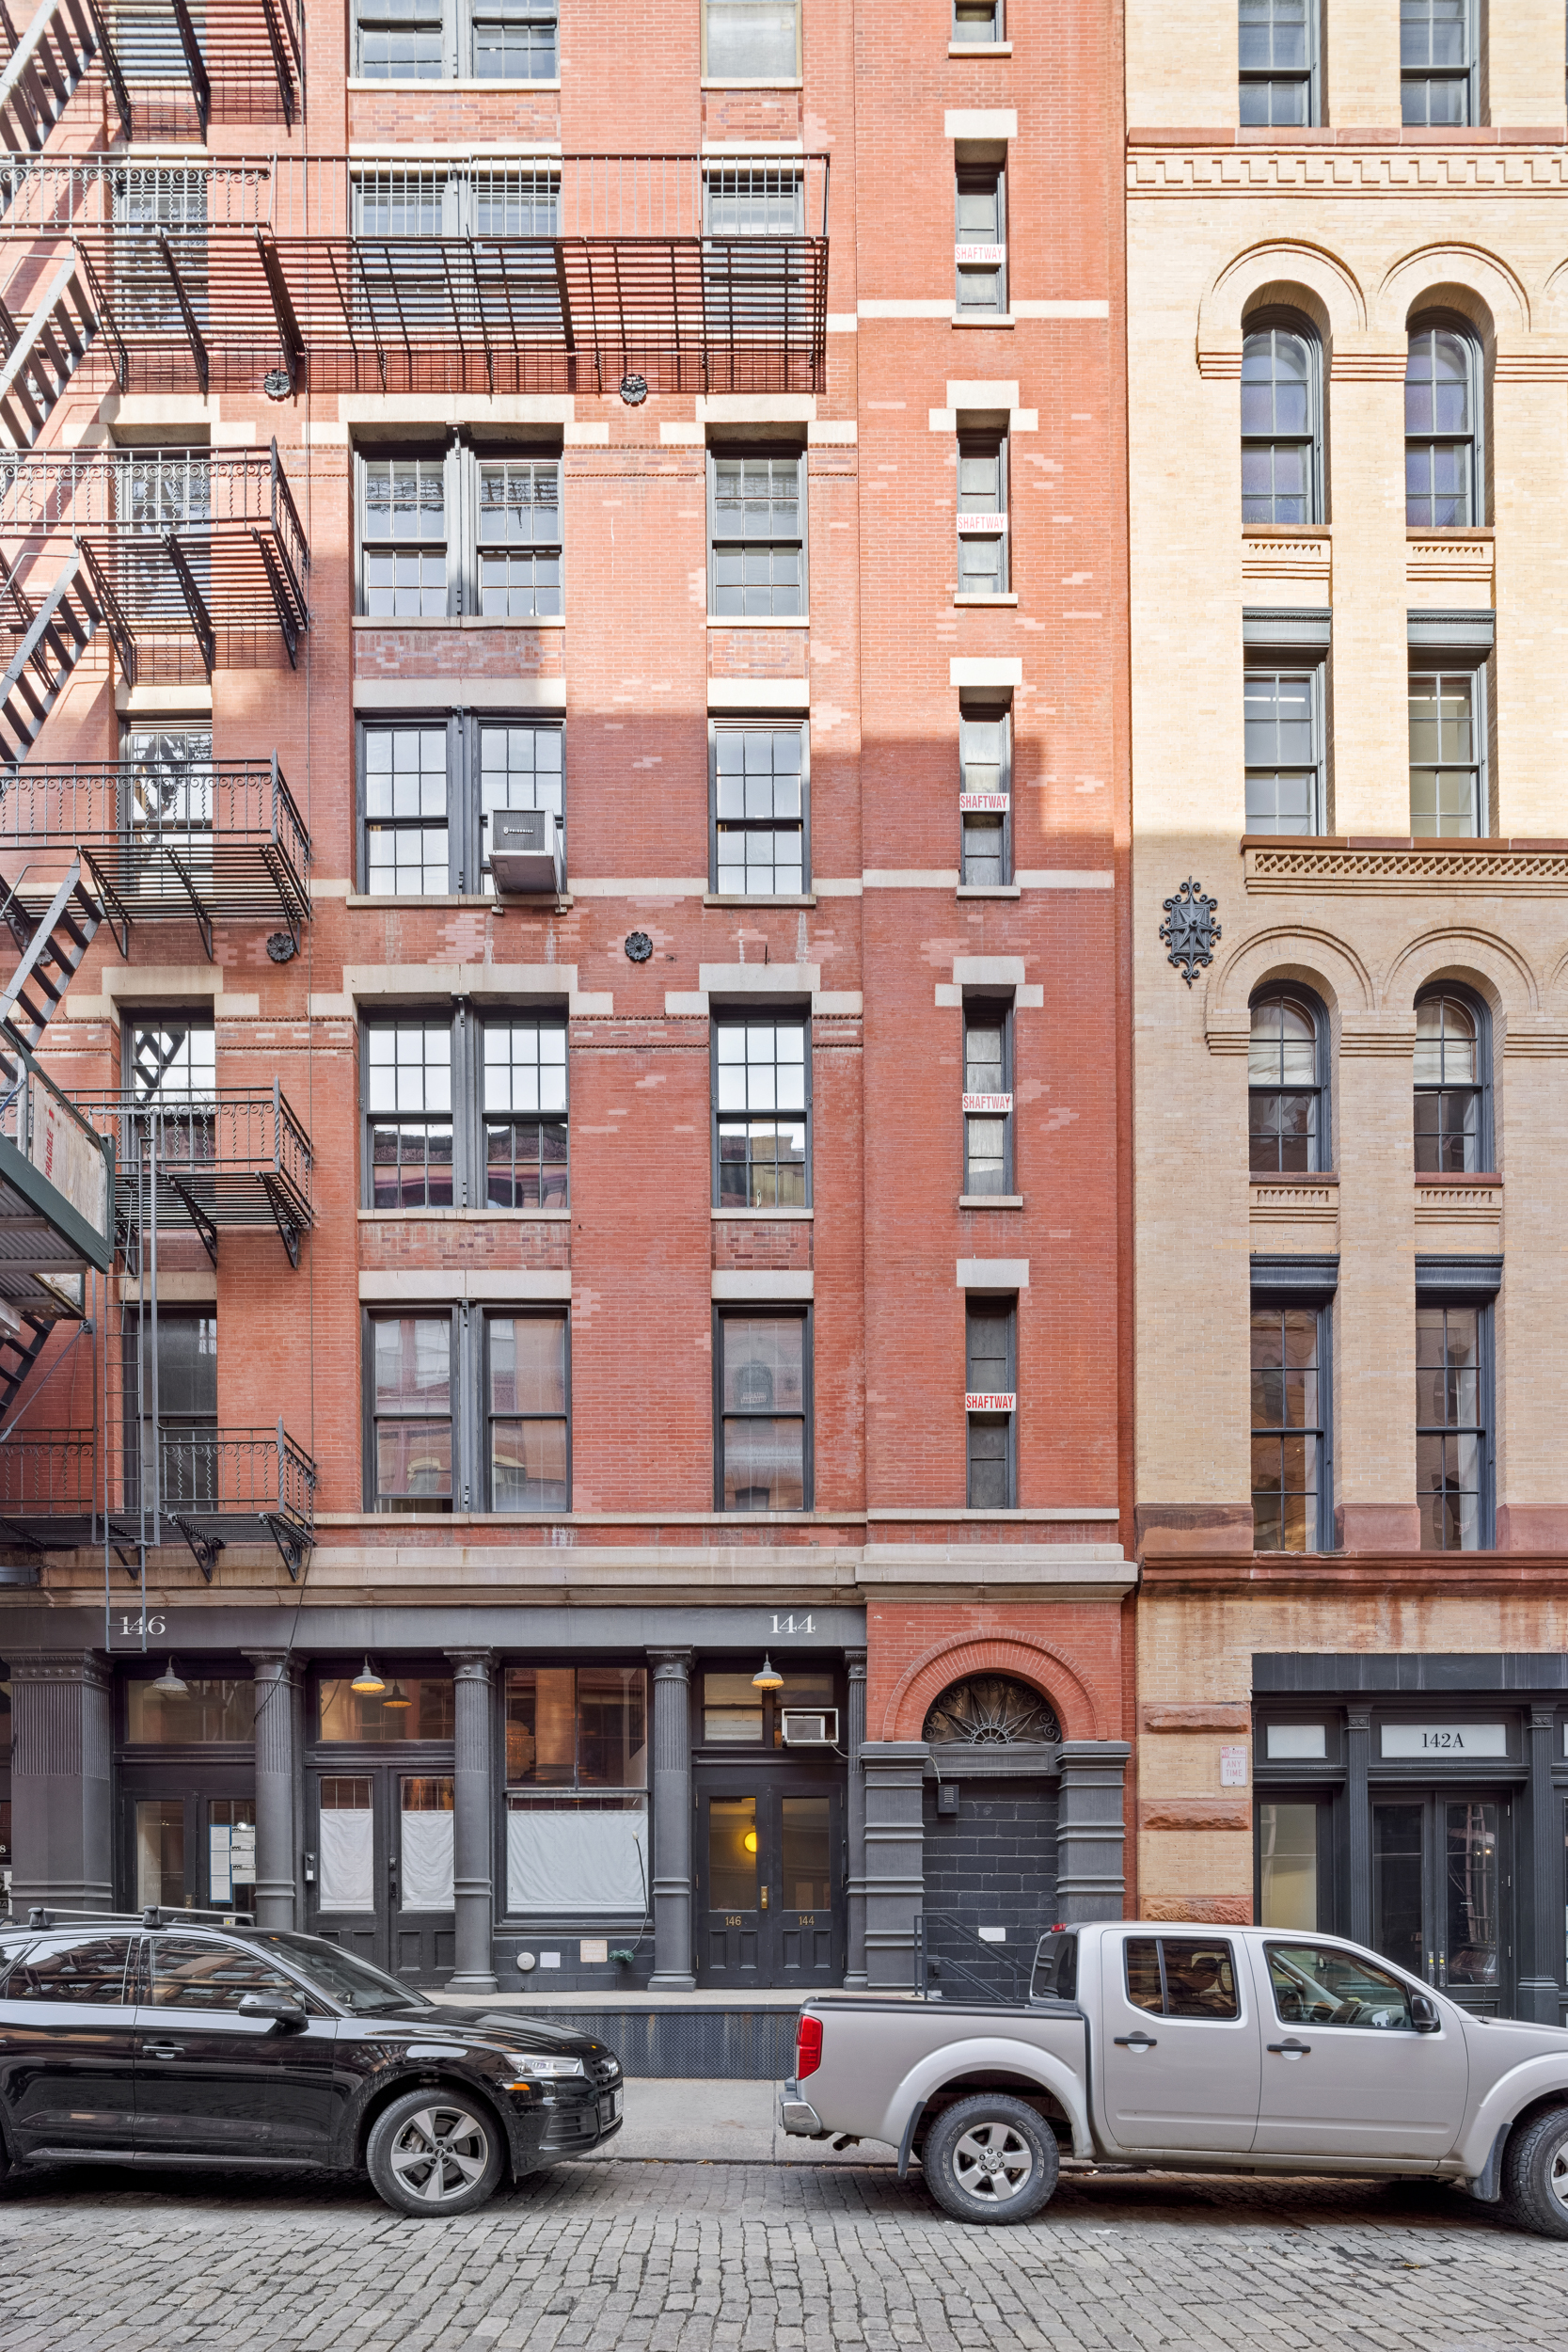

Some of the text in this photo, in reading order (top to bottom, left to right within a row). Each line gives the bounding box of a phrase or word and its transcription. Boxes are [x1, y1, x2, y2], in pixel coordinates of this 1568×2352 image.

[956, 246, 1003, 260] SHAFTWAY
[958, 516, 1005, 530] SHAFTWAY
[960, 795, 1007, 809] SHAFTWAY
[963, 1095, 1010, 1109] SHAFTWAY
[44, 1127, 55, 1180] FRAGILE
[966, 1395, 1014, 1408] SHAFTWAY
[119, 1614, 166, 1635] 146
[768, 1614, 816, 1634] 144
[1421, 1732, 1465, 1748] 142A
[1226, 1760, 1242, 1769] ANY
[1225, 1769, 1243, 1777] TIME
[725, 1915, 742, 1926] 146
[799, 1915, 815, 1926] 144
[1014, 2120, 1045, 2179] COOPER
[942, 2151, 1000, 2213] DISCOVERER
